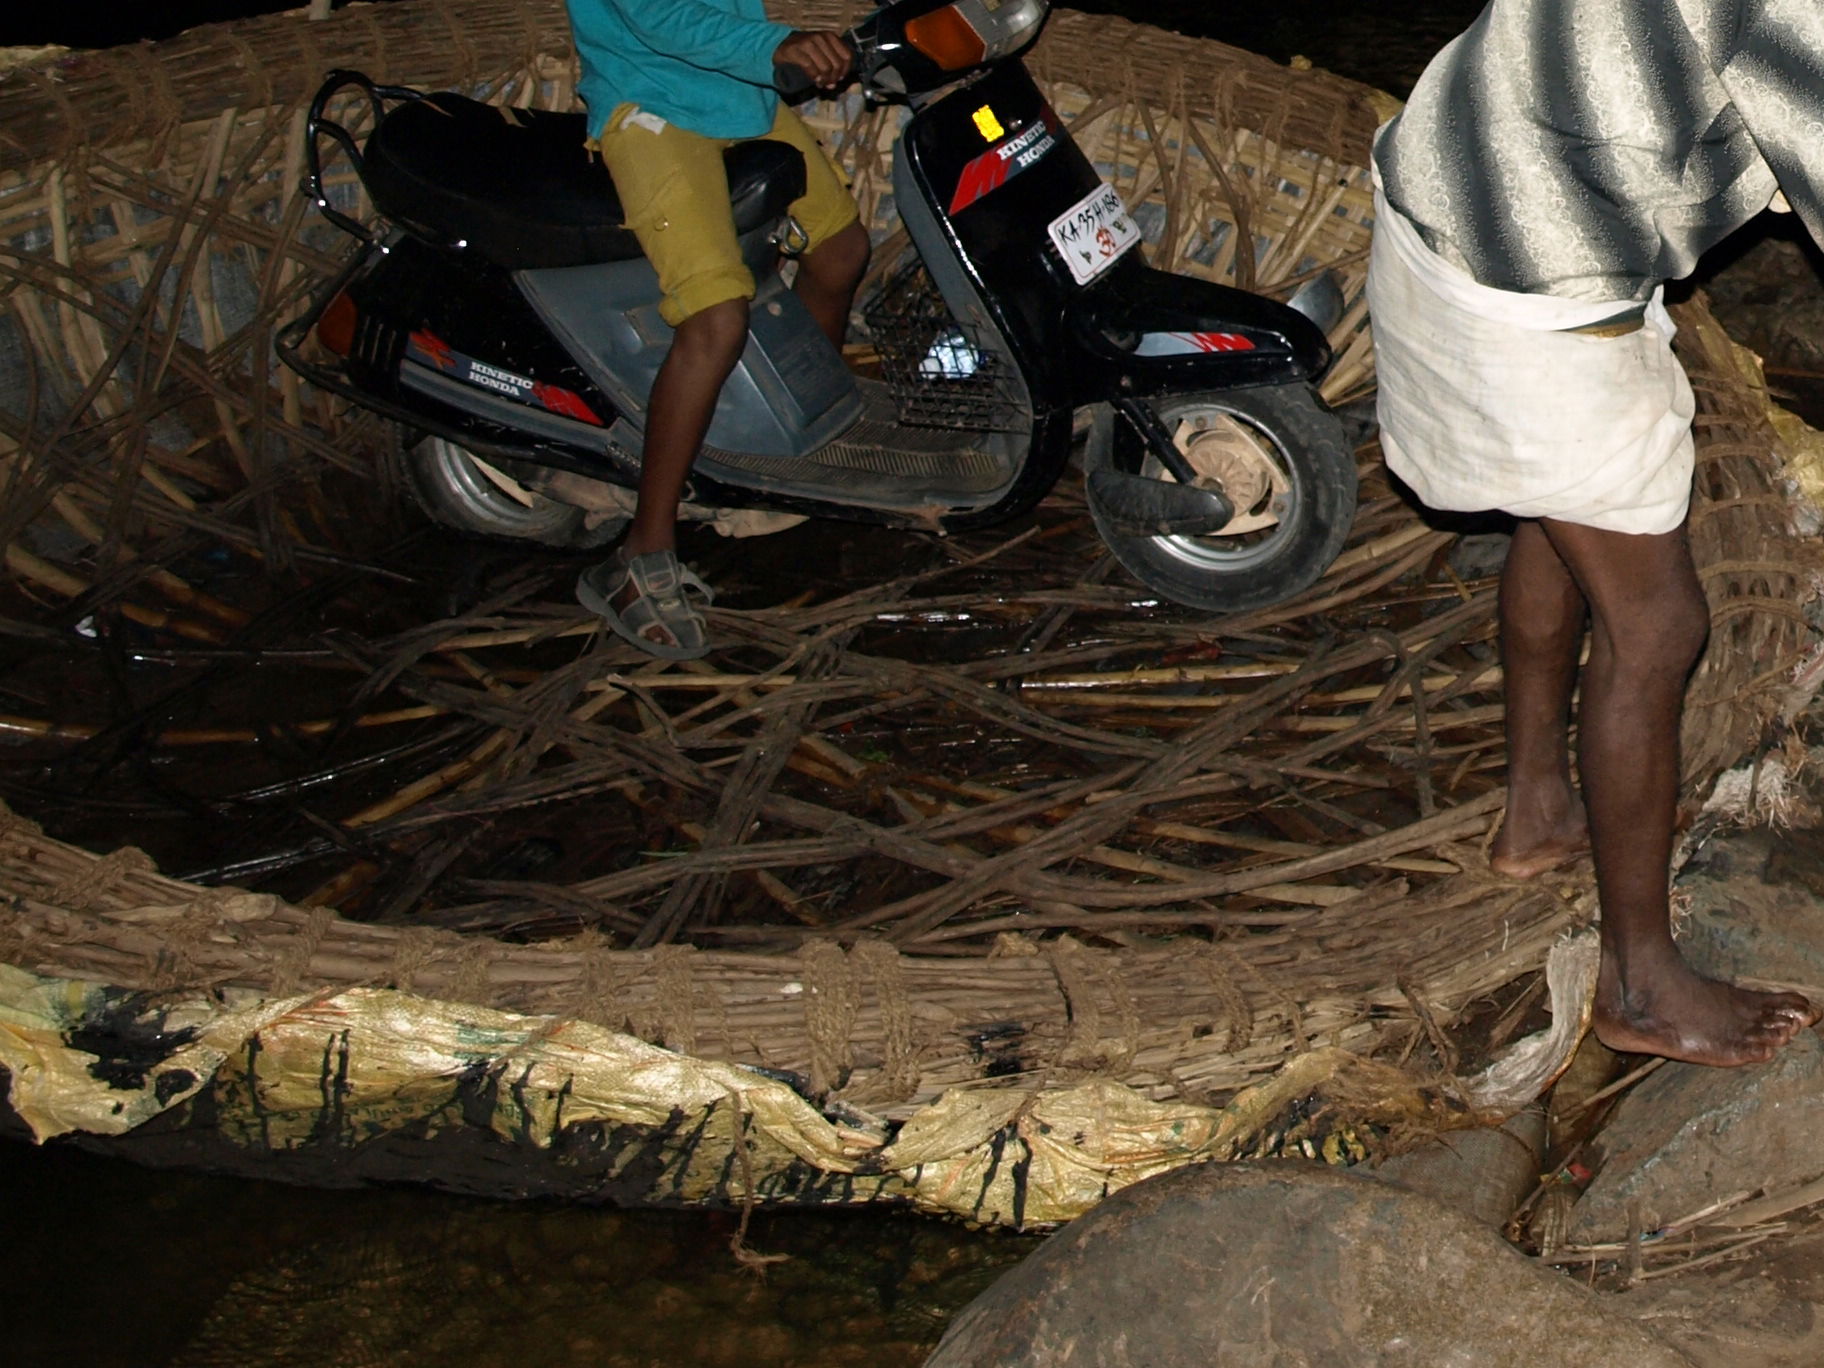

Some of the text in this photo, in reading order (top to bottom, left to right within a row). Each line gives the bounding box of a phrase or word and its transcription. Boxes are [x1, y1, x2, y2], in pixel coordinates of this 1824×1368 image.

[996, 120, 1046, 160] KINETIC
[1016, 135, 1056, 167] HONDA
[469, 362, 534, 389] KINETIC
[469, 371, 520, 396] HONDA
